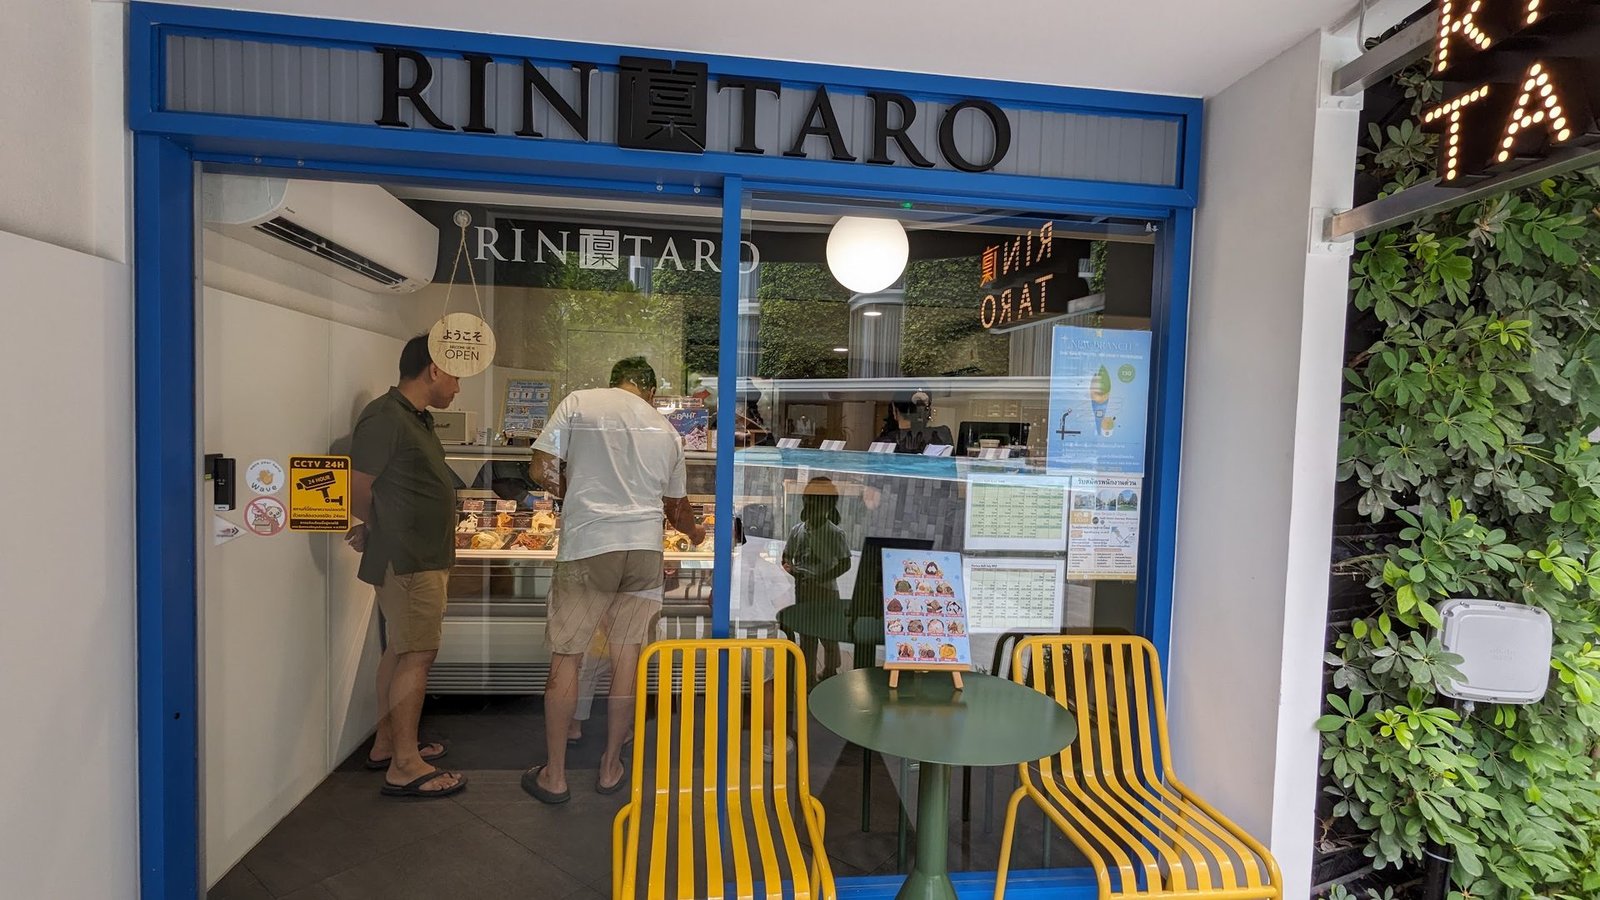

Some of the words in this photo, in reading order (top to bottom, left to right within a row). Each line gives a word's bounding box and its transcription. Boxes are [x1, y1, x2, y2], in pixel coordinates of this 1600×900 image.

[373, 46, 598, 142] RIN
[717, 76, 1011, 172] TARO
[474, 226, 571, 265] RIN
[443, 329, 482, 342] ようこそ
[445, 349, 479, 360] OPEN
[293, 460, 320, 468] CCTV
[325, 461, 345, 469] 24H
[251, 482, 277, 492] Wave
